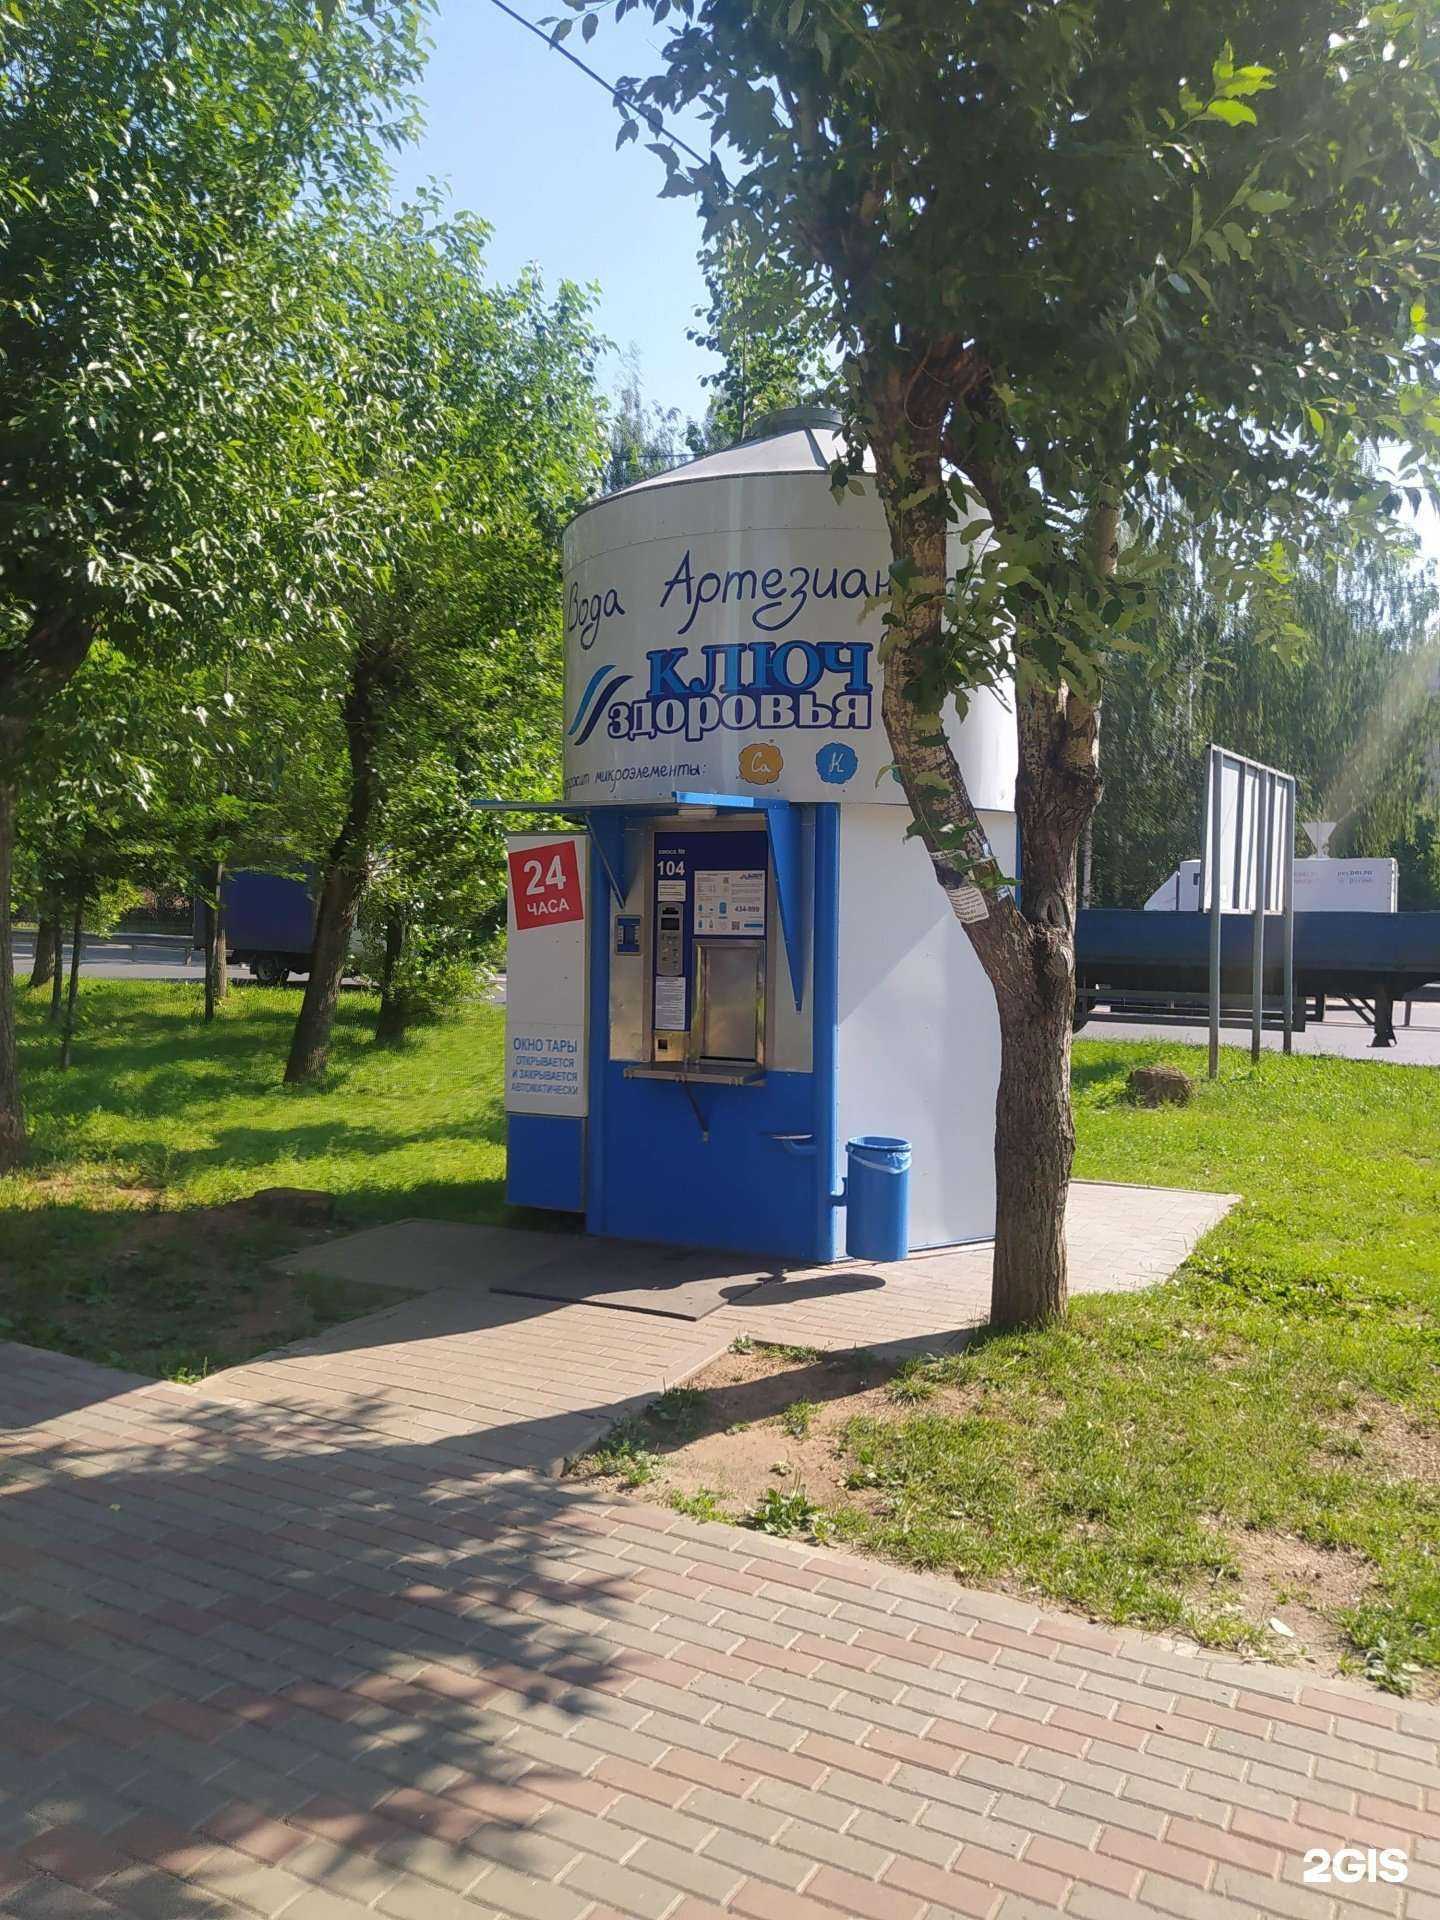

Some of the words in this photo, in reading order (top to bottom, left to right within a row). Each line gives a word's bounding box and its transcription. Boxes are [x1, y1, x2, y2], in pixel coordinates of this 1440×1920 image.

[567, 581, 626, 650] Вода
[659, 550, 893, 634] Артезиан
[594, 763, 707, 793] микроэлементы:
[523, 855, 567, 896] 24
[656, 860, 685, 876] 104
[526, 898, 570, 916] ЧАСА
[513, 1037, 544, 1052] ОКНО
[545, 1038, 577, 1053] ТАРЫ
